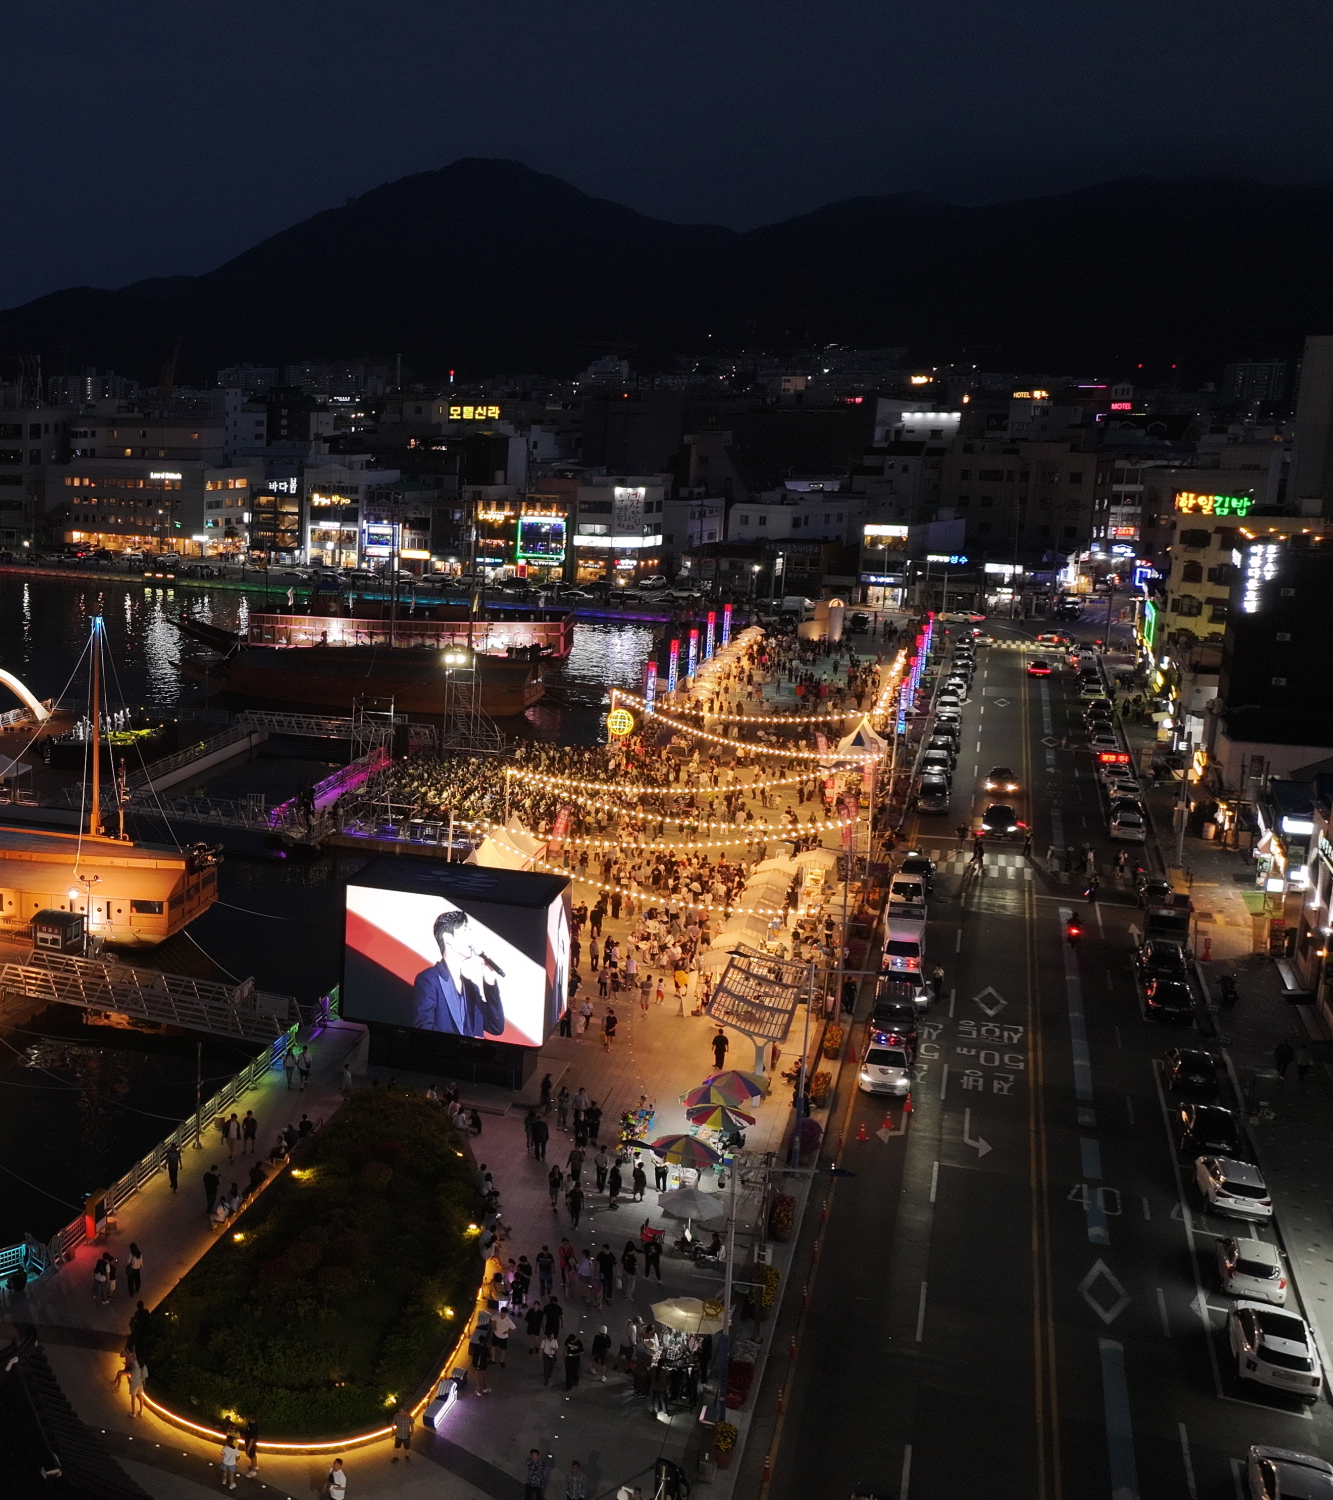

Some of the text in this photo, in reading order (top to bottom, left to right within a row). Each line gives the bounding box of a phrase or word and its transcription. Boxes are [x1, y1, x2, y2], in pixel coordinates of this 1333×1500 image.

[449, 405, 501, 420] 모텔신라
[1111, 402, 1132, 410] MOTEL
[268, 477, 298, 494] 바다봄
[1178, 491, 1252, 517] 한일김밥
[1263, 544, 1279, 581] STAY
[957, 1019, 1024, 1044] 신호등
[955, 1046, 1025, 1071] 50m
[959, 1069, 1015, 1096] 전방
[1066, 1182, 1123, 1216] 40
